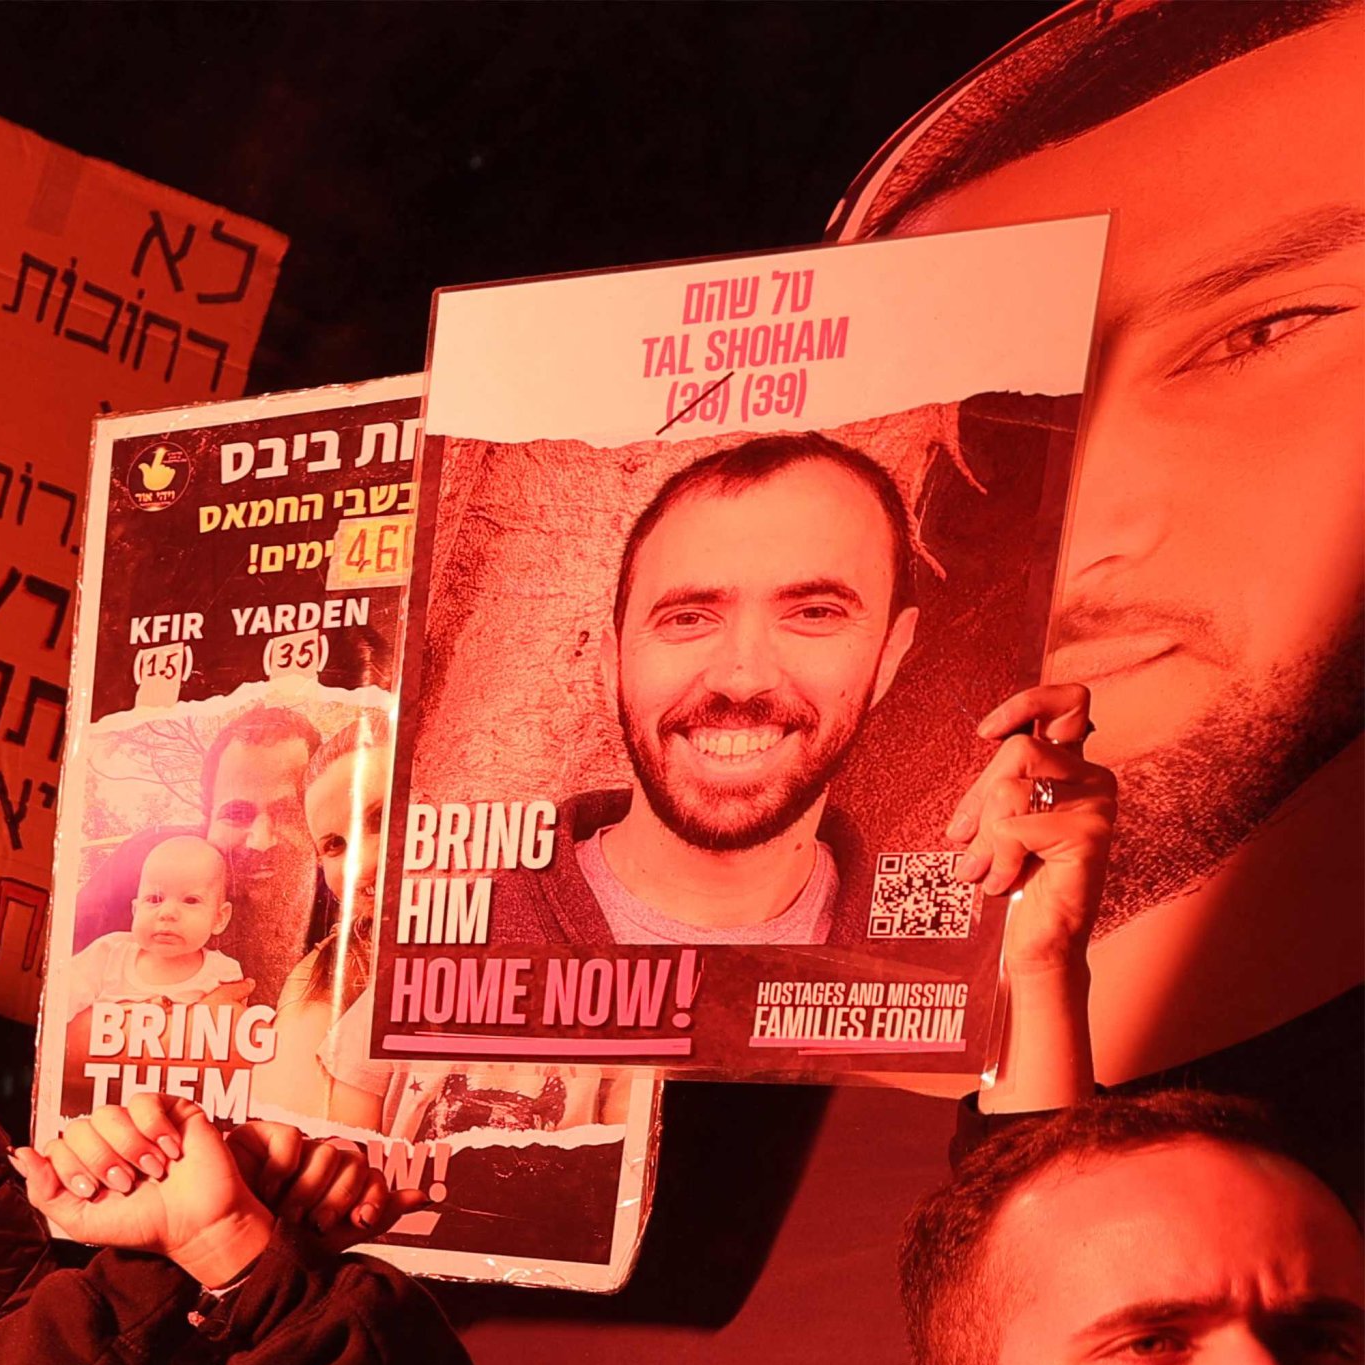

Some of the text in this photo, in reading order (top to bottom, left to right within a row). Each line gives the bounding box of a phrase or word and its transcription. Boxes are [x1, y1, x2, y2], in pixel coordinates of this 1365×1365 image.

[131, 209, 260, 304] לא
[682, 268, 815, 325] טל שהם
[642, 315, 850, 378] TAL SHOHAM
[740, 368, 808, 423] (39)
[221, 429, 342, 485] ביבס
[199, 493, 326, 534] החמאס
[129, 596, 371, 645] KFIR YARDEN
[263, 634, 330, 676] (35)
[403, 800, 558, 871] BRING
[396, 877, 493, 944] HIM
[390, 949, 706, 1029] HOME NOW!
[756, 981, 969, 1009] HOSTAGES AND MISSING
[88, 1002, 279, 1064] BRING
[752, 1006, 965, 1043] FAMILIES FORUM
